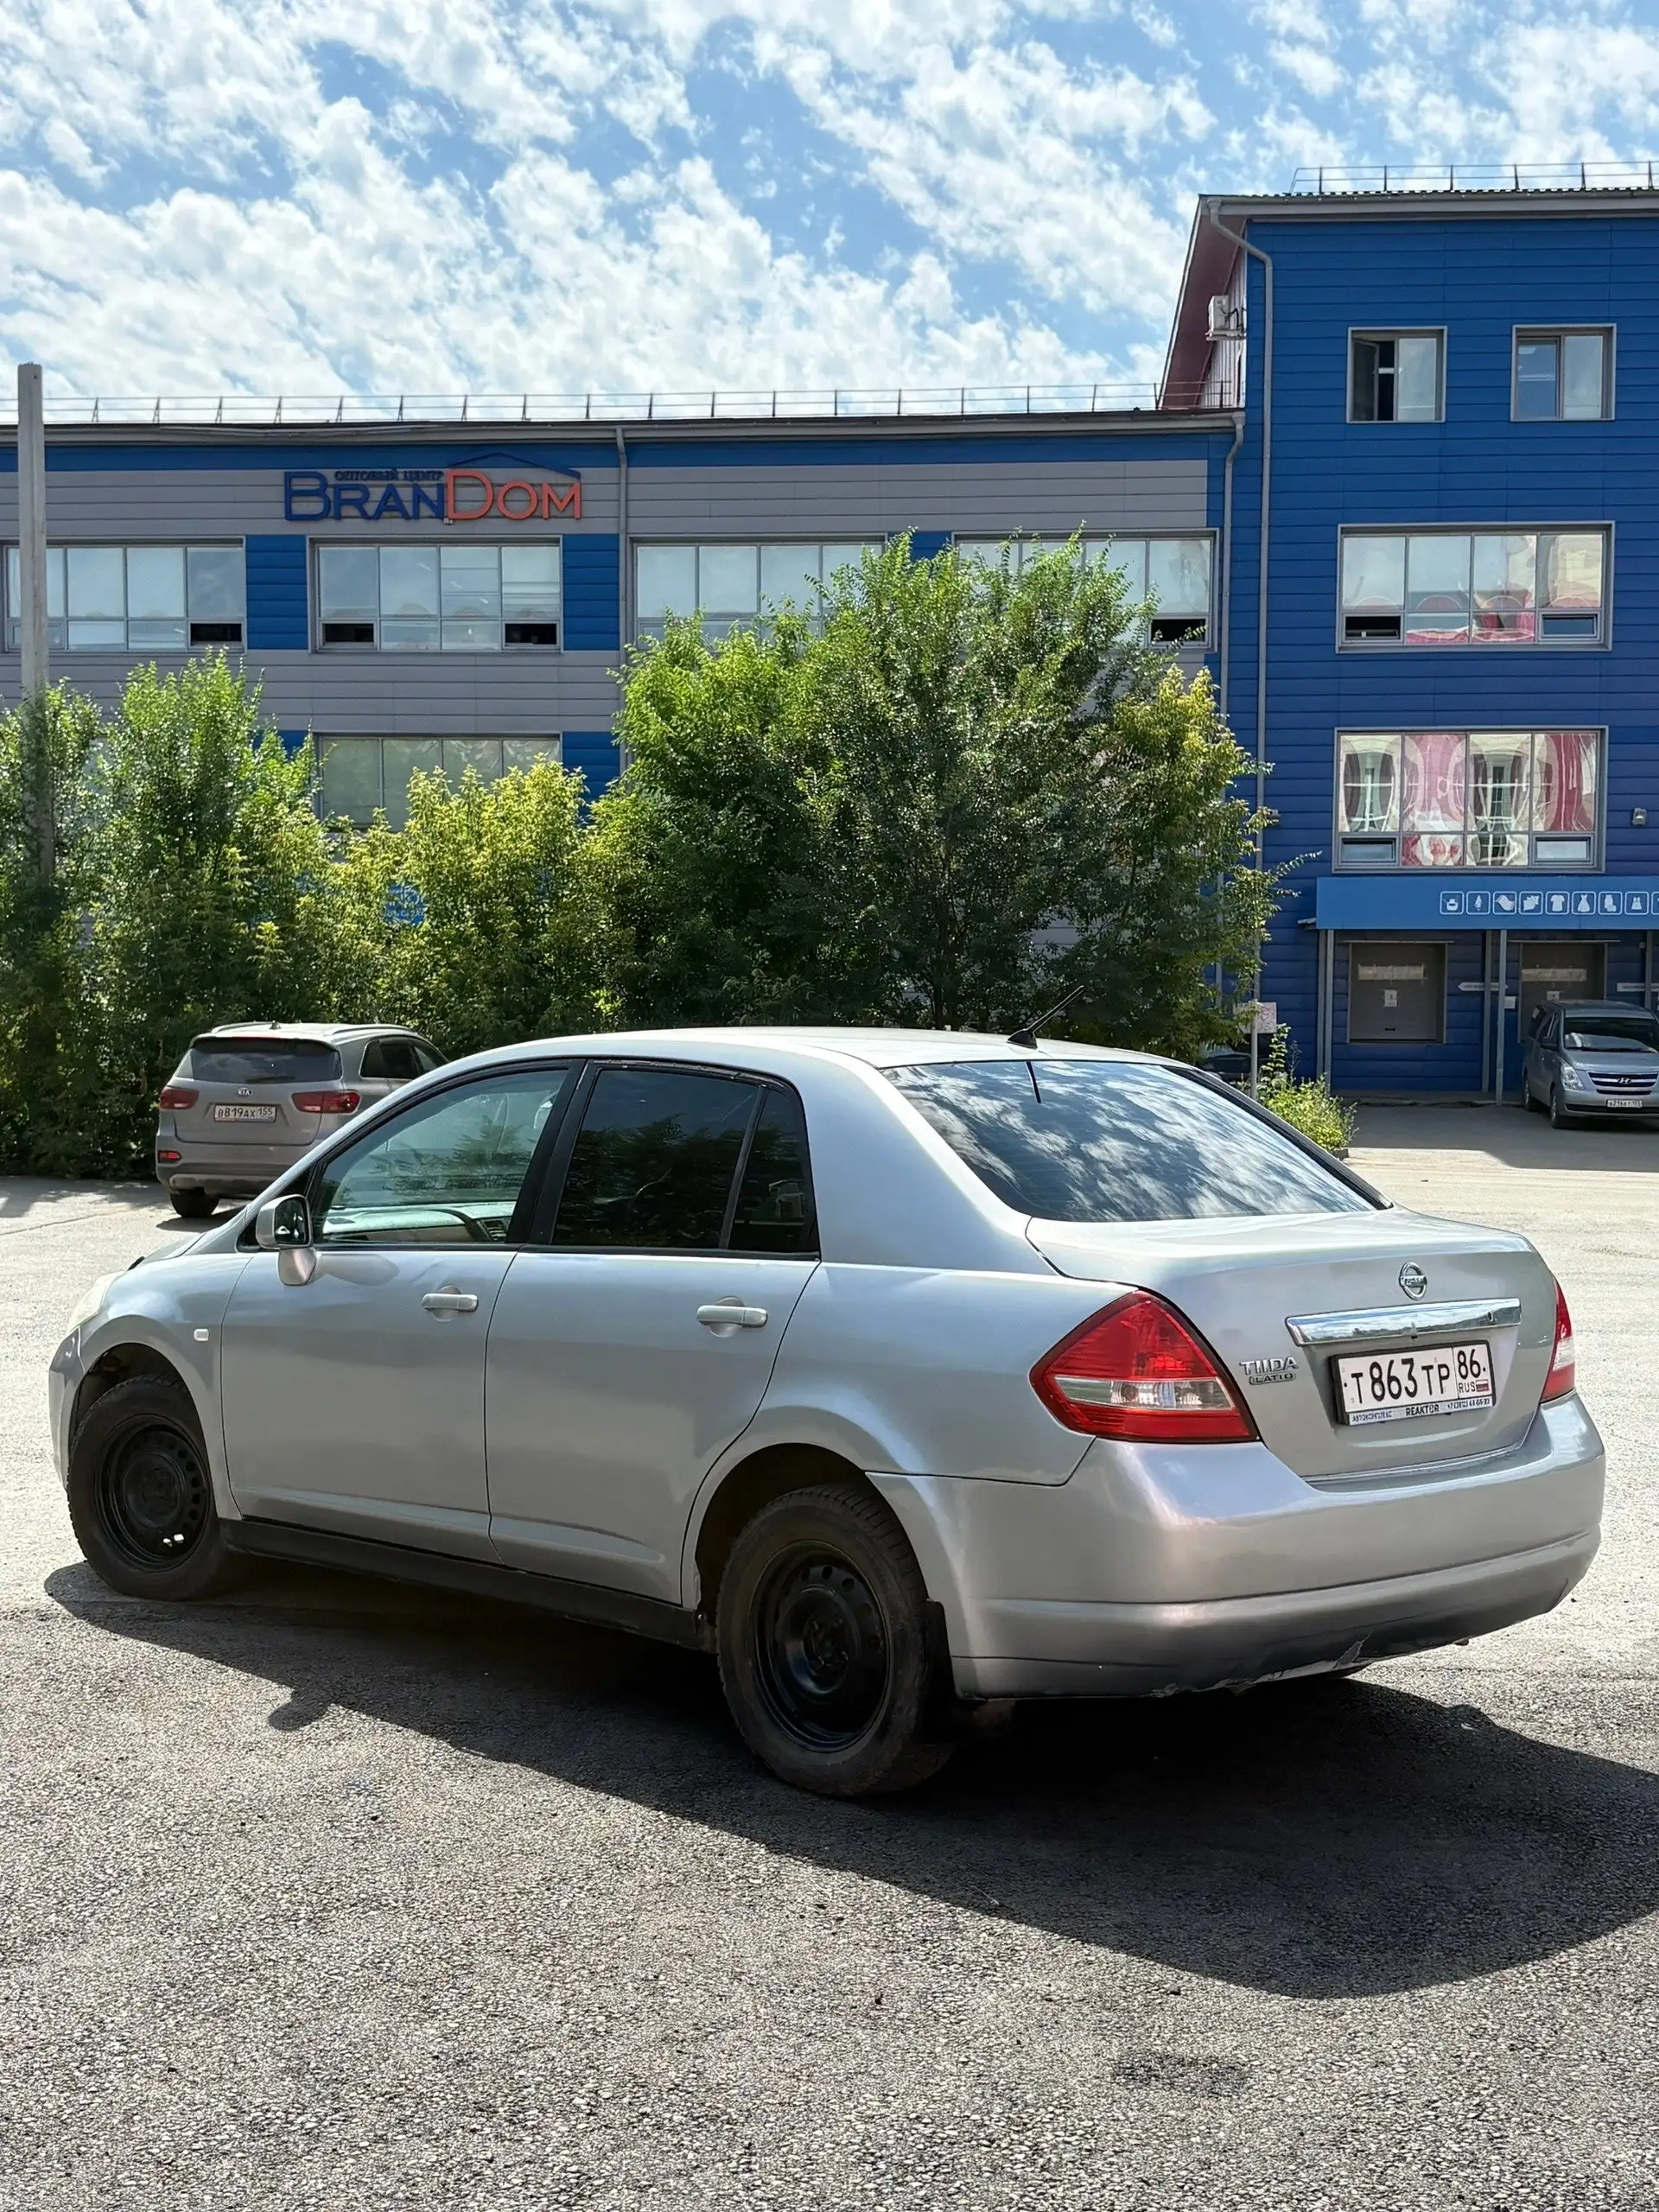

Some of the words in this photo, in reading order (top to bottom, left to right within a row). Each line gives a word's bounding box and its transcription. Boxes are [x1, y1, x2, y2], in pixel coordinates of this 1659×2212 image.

[258, 1107, 273, 1116] 155
[1239, 1357, 1299, 1376] TIIDA
[1457, 1349, 1481, 1380] 86
[1255, 1372, 1294, 1383] LATIO
[1459, 1381, 1476, 1394] RUS
[1405, 1404, 1440, 1417] REAKTOR
